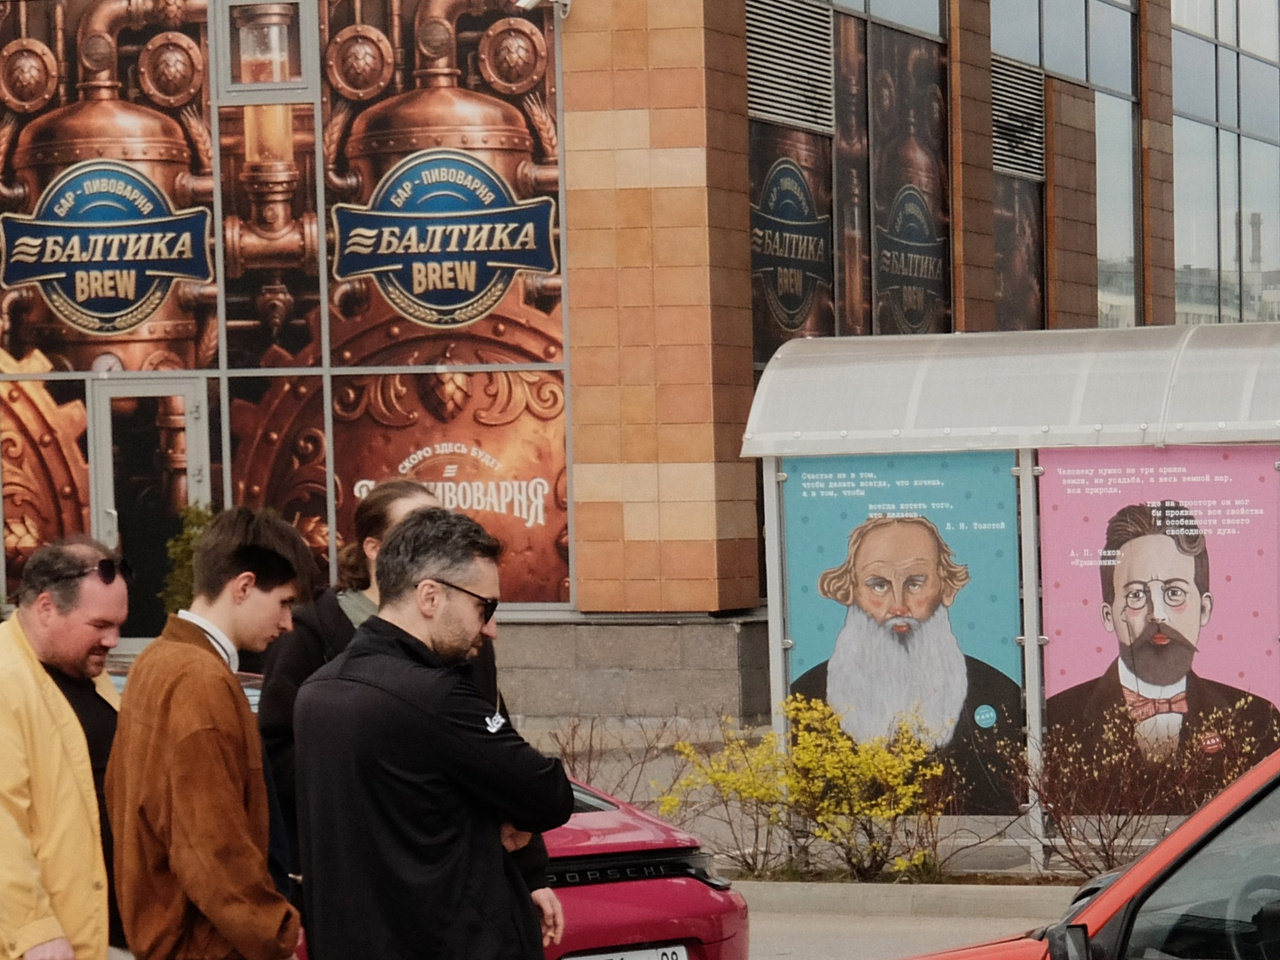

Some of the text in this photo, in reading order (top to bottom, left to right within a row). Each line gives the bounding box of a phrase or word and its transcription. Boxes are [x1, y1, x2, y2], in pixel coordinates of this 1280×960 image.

[53, 191, 76, 217] БАР
[83, 178, 154, 215] ПИВОВАРНЯ
[390, 181, 413, 208] БАР
[421, 168, 496, 205] ПИВОВАРНЯ
[41, 231, 194, 263] БАЛТИКА
[377, 222, 537, 254] БАЛТИКА
[764, 230, 824, 261] БАЛТИКА
[891, 251, 942, 280] БАЛТИКА
[75, 269, 137, 303] BREW
[411, 260, 477, 295] BREW
[398, 442, 503, 474] СКОРО ЗДЕСЬ БУДЕТ
[801, 472, 833, 480] Счастье
[1057, 468, 1095, 477] Человеку
[1098, 468, 1122, 476] нужно
[1139, 467, 1154, 475] три
[802, 481, 825, 489] чтобы
[828, 481, 856, 489] делать
[859, 480, 891, 488] всегда,
[913, 479, 945, 487] хочешь,
[820, 490, 838, 498] том,
[842, 489, 865, 497] чтобы
[1085, 487, 1122, 496] природа,
[421, 478, 549, 528] ИВОВАРНЯ
[868, 502, 953, 511] всегда хотеть того,
[1165, 509, 1203, 517] проявить
[1226, 507, 1264, 515] свойства
[972, 521, 1006, 530] Толстой
[1165, 518, 1218, 526] особенности
[1165, 527, 1241, 536] свободного духа.
